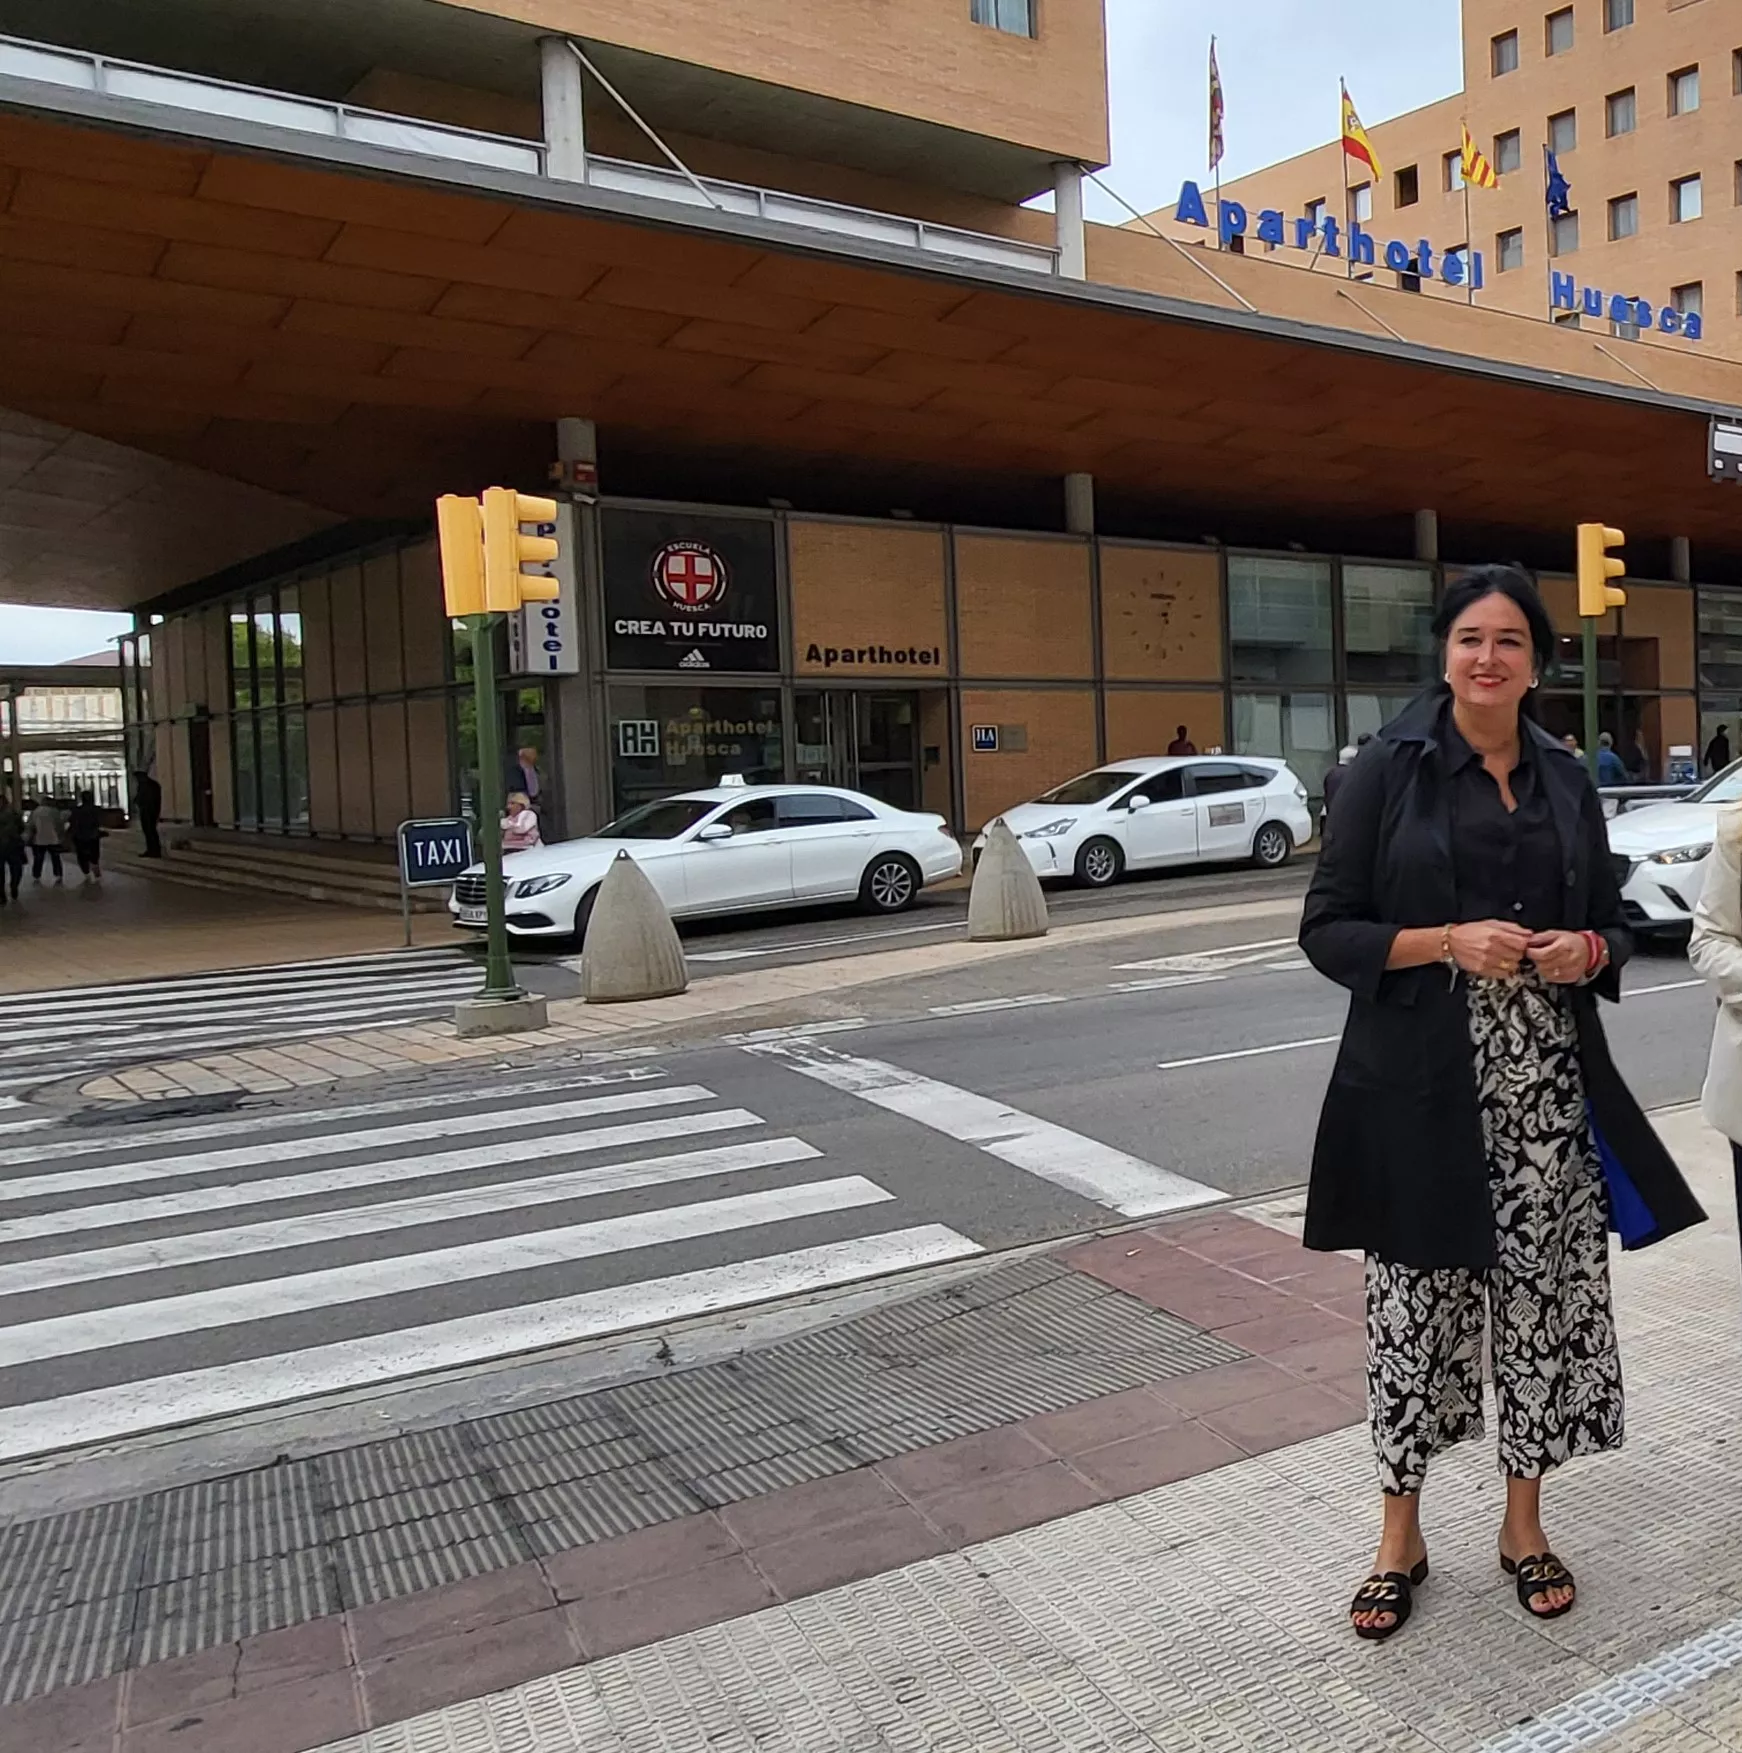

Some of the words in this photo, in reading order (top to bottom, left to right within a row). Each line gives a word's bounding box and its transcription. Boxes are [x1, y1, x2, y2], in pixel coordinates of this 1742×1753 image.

[1174, 180, 1483, 290] Aparthotel
[1552, 271, 1702, 339] Huesca
[667, 542, 711, 553] ESCUELA
[673, 601, 711, 612] HUESCA
[615, 620, 666, 635] CREA
[670, 622, 694, 636] TU
[698, 623, 767, 638] FUTURO
[806, 643, 940, 667] Aparthotel
[666, 719, 774, 735] Aparthotel
[413, 838, 462, 867] TAXI
